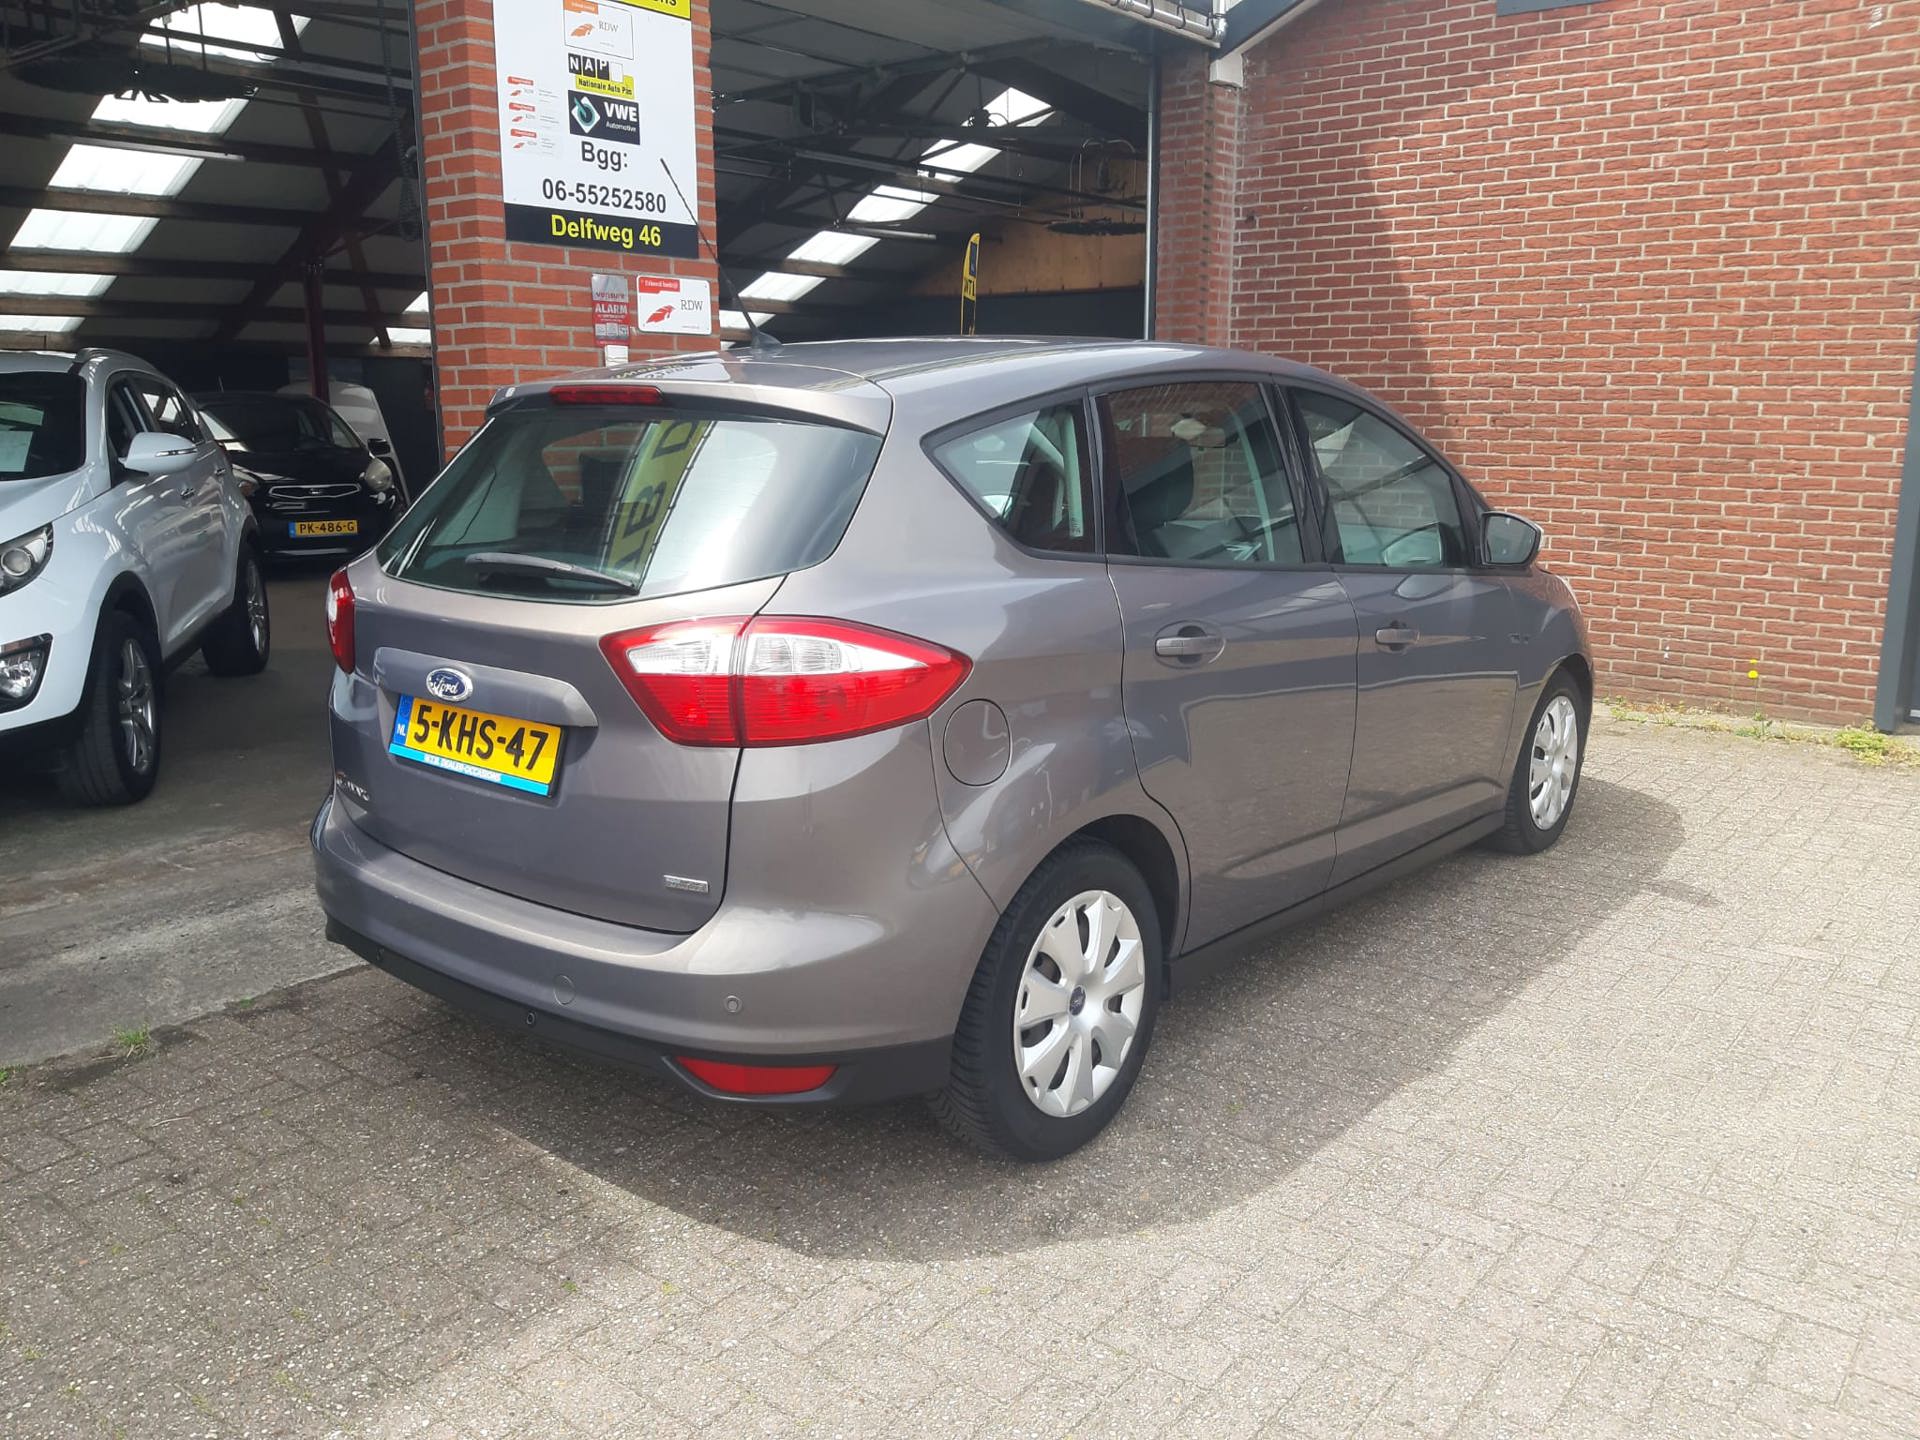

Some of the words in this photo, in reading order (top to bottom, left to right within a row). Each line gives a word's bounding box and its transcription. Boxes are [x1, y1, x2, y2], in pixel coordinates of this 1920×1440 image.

[568, 55, 609, 73] NAP
[604, 101, 638, 122] VWE
[606, 121, 637, 133] Automotive
[581, 141, 628, 172] Bgg:
[542, 178, 667, 214] 06-55252580
[551, 215, 634, 249] Delfweg
[639, 225, 662, 247] 46
[595, 302, 628, 315] ALARM
[680, 299, 703, 311] RDW
[300, 521, 355, 534] PK-486-G
[430, 675, 459, 696] Ford
[414, 704, 550, 771] 5-KHS-47
